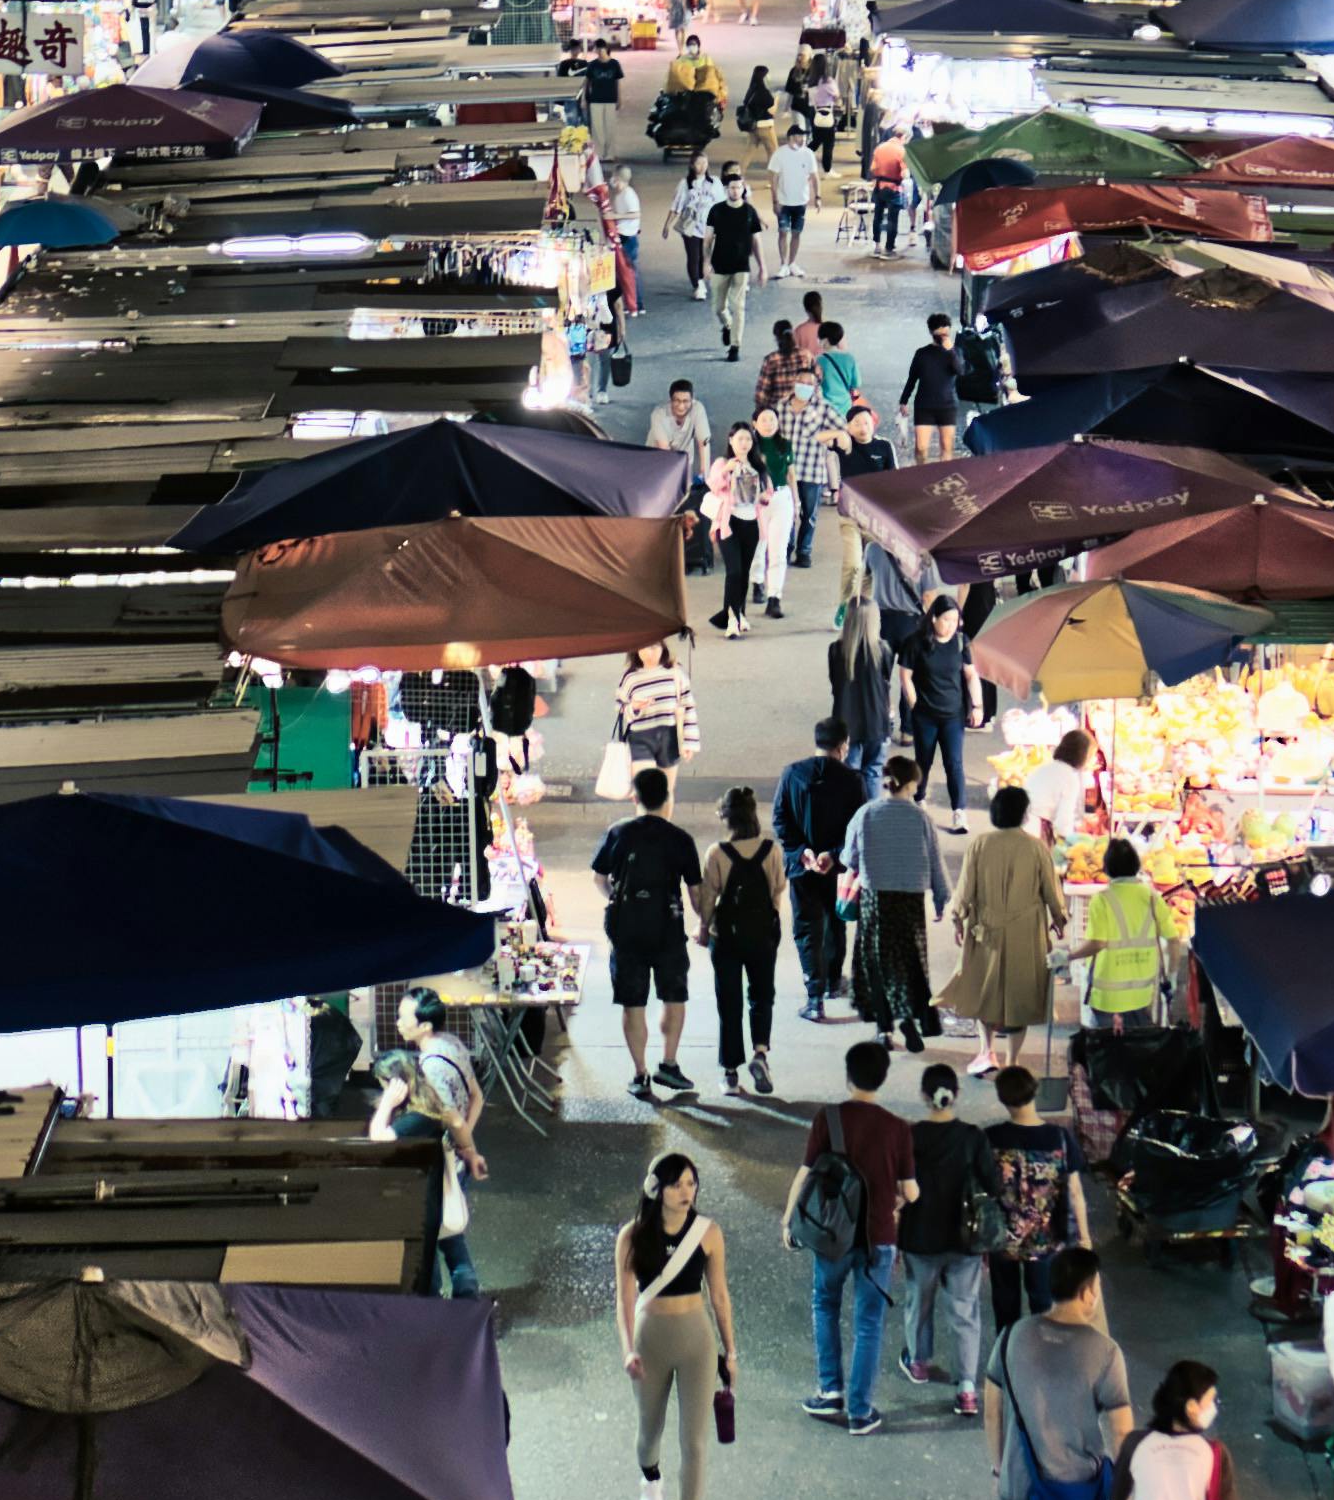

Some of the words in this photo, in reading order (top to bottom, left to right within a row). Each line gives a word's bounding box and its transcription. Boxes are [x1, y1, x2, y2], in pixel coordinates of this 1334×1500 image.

[92, 115, 164, 128] Yedpay
[19, 150, 60, 163] Yedpay
[1081, 487, 1190, 516] Yedpay
[1006, 546, 1067, 569] Yedpay
